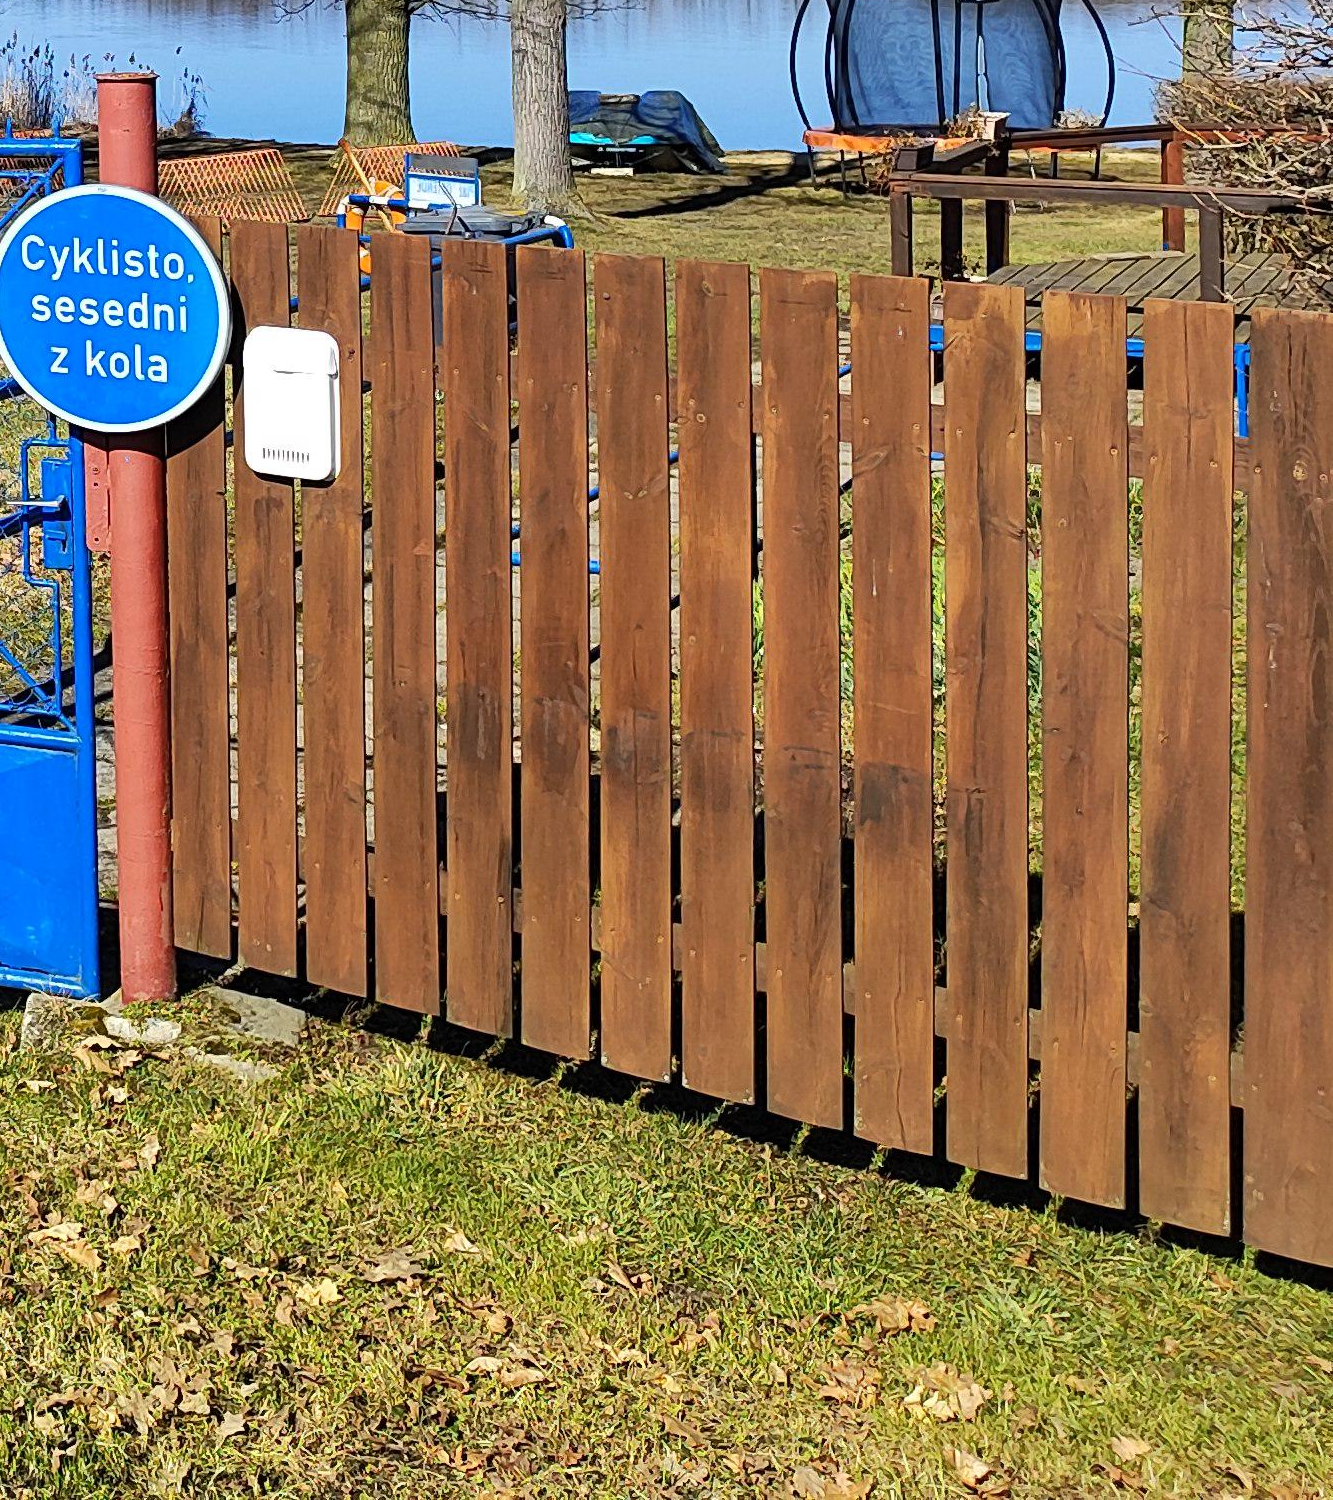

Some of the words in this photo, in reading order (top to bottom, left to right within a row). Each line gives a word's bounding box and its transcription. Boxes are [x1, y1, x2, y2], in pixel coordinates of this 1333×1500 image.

[20, 235, 195, 284] Cyklisto,
[31, 292, 188, 333] sesedni
[50, 346, 69, 375] z
[85, 340, 169, 383] kola
